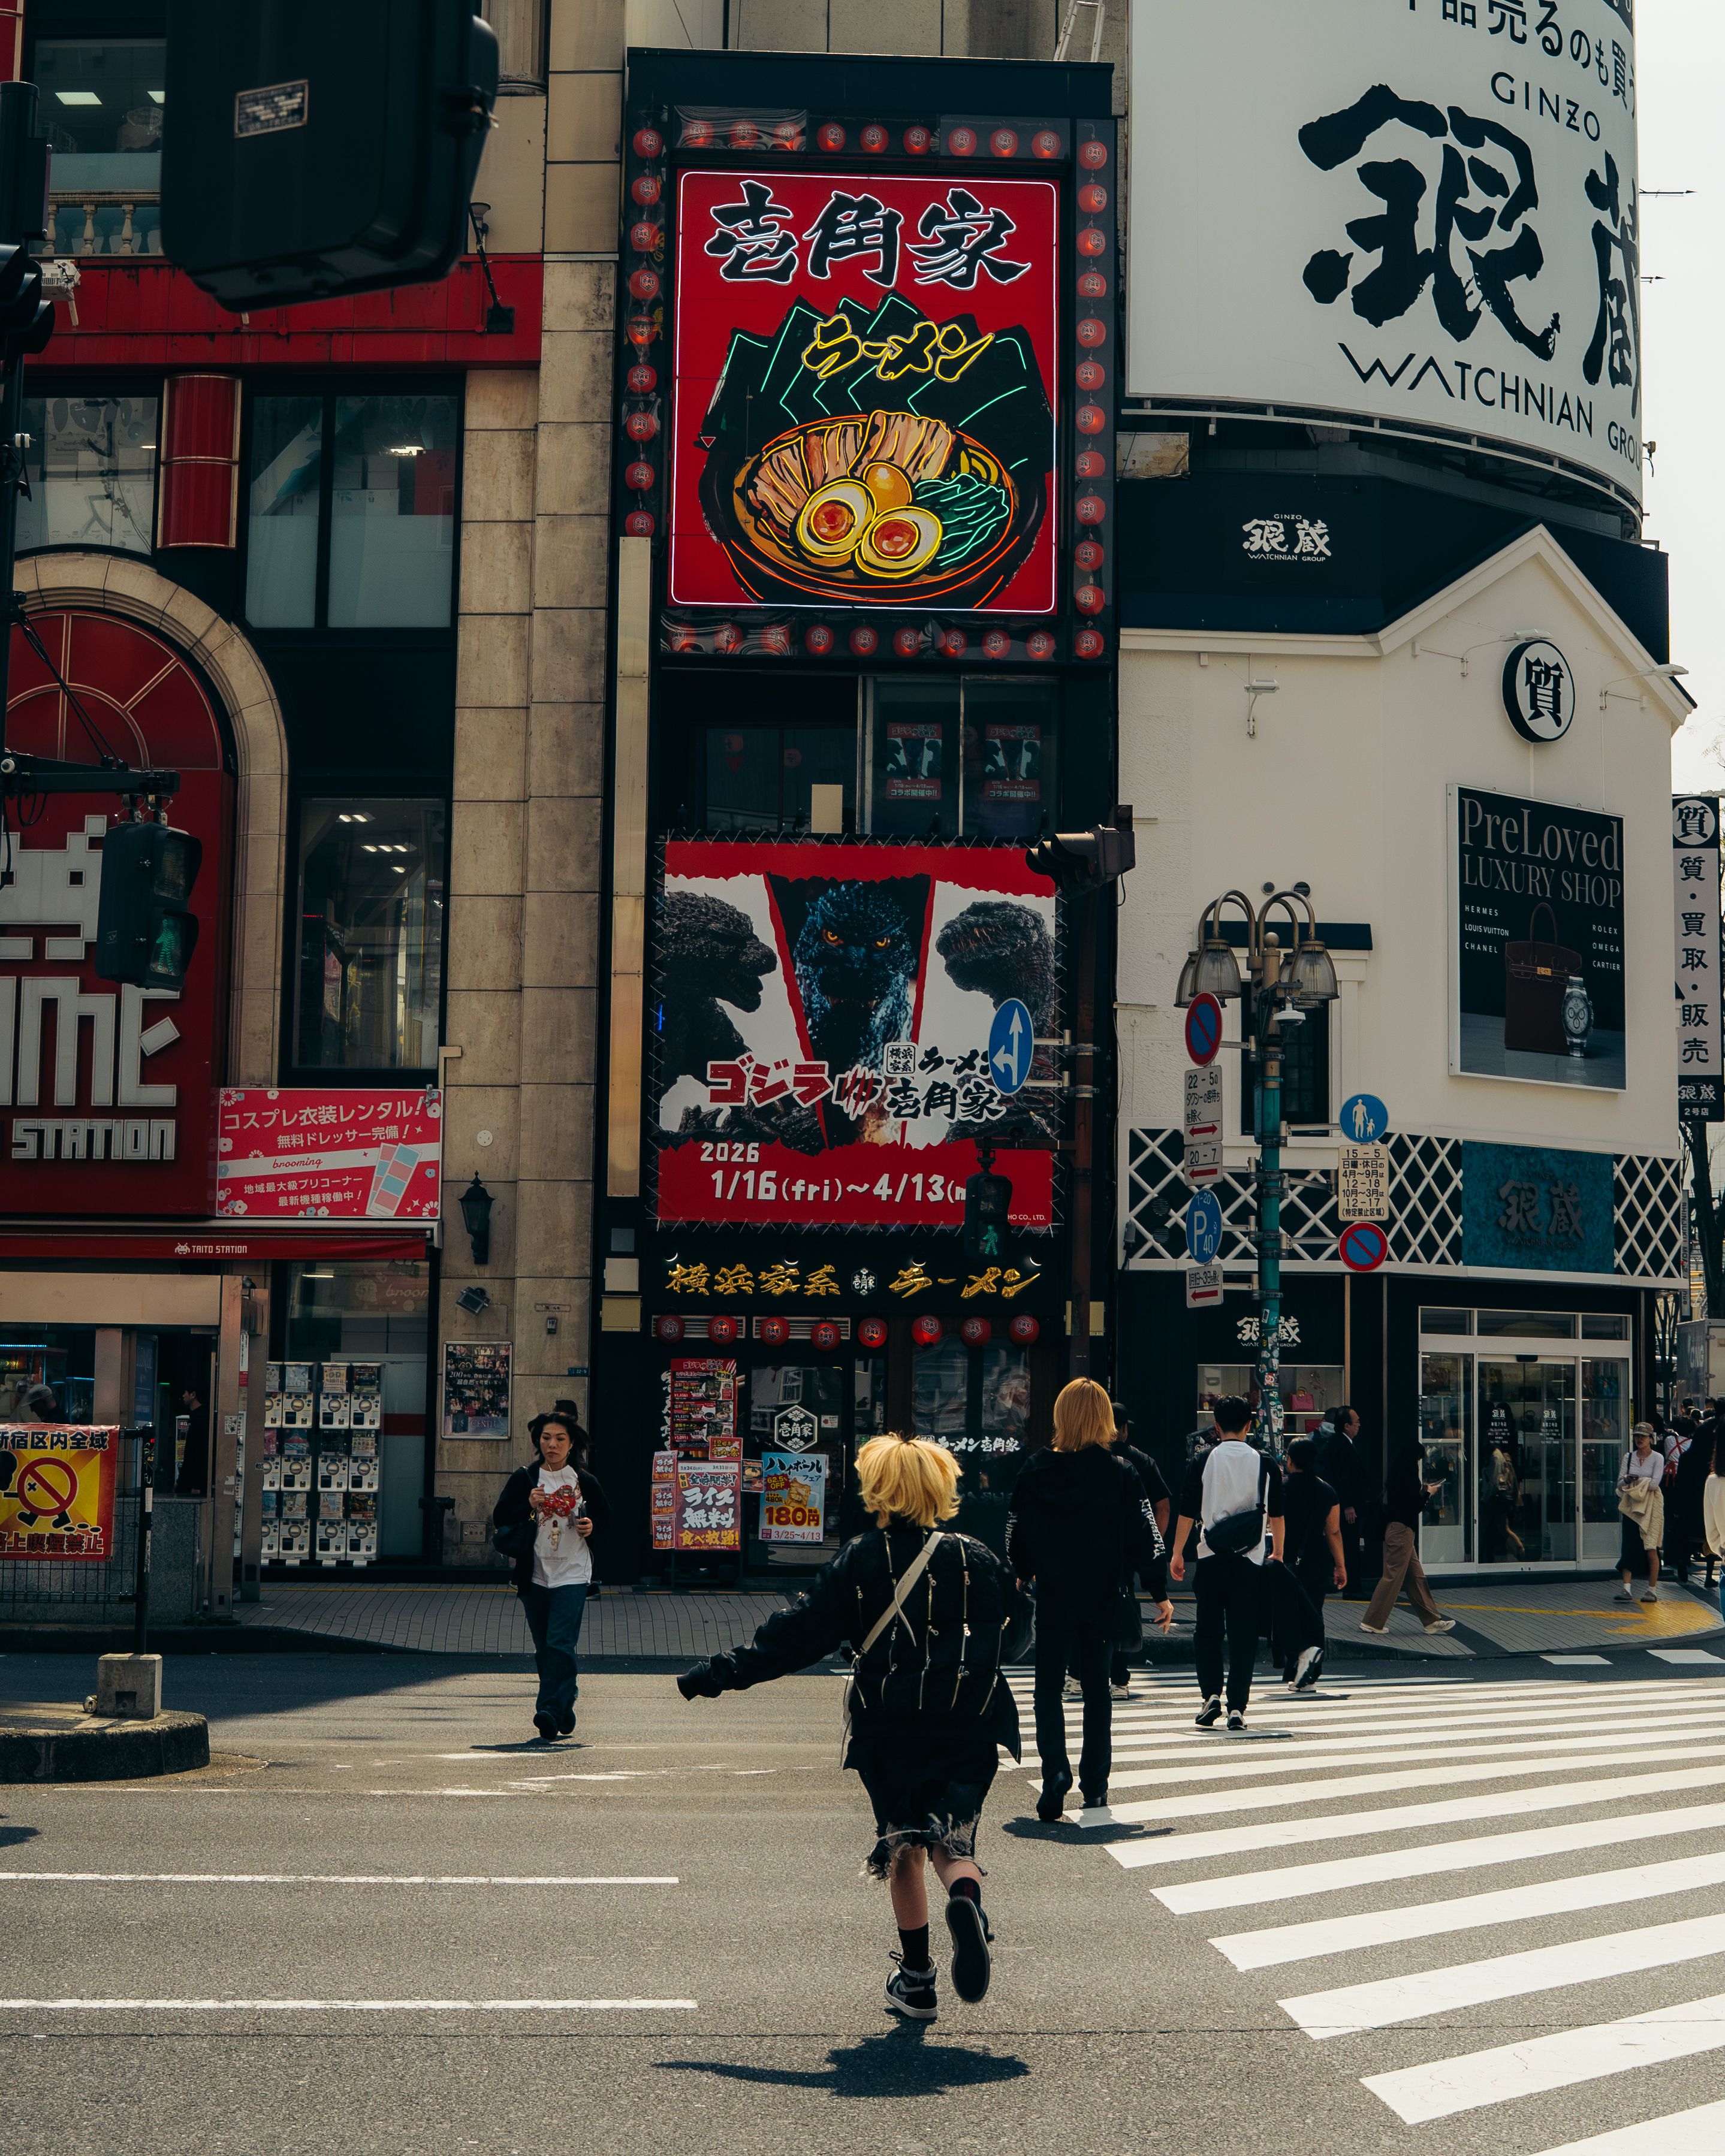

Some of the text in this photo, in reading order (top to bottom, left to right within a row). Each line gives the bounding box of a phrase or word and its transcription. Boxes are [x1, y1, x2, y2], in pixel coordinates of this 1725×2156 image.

[1491, 72, 1600, 141] GINZO
[803, 315, 995, 380] ラーメン
[1338, 342, 1640, 471] WATCHNIAN GROU
[1525, 656, 1564, 727] 質
[1677, 805, 1709, 839] 質
[1461, 797, 1621, 871] PreLoved
[1463, 854, 1621, 908] LUXURY SHOP
[1465, 905, 1498, 916] HERMES
[1465, 923, 1509, 936] LOUIS VUITTON
[1593, 925, 1618, 935] ROLEX
[1465, 942, 1498, 953] CHANEL
[1593, 942, 1620, 953] OMEGA
[1593, 961, 1620, 971] CARTIER
[708, 1053, 832, 1106] ゴジラ
[1186, 1089, 1220, 1106] タクシーの客待ち
[1186, 1109, 1202, 1123] を除く
[12, 1118, 176, 1160] STATION
[276, 1124, 410, 1149] 無料ドレッサー完備!
[700, 1142, 760, 1162] 2026
[273, 1157, 323, 1169] brooming
[1343, 1160, 1385, 1169] 日曜・休日の
[243, 1176, 363, 1194] 地域最大級プリコーナー
[1194, 1210, 1207, 1256] P
[192, 1245, 248, 1254] TAITO STATION
[665, 1263, 840, 1296] 横浜家系
[889, 1267, 1041, 1299] ラーメン
[779, 1422, 813, 1438] 壱角家
[765, 1457, 822, 1475] ハイボール
[681, 1487, 735, 1507] ライス
[681, 1508, 735, 1529] 無料
[765, 1506, 819, 1527] 180円
